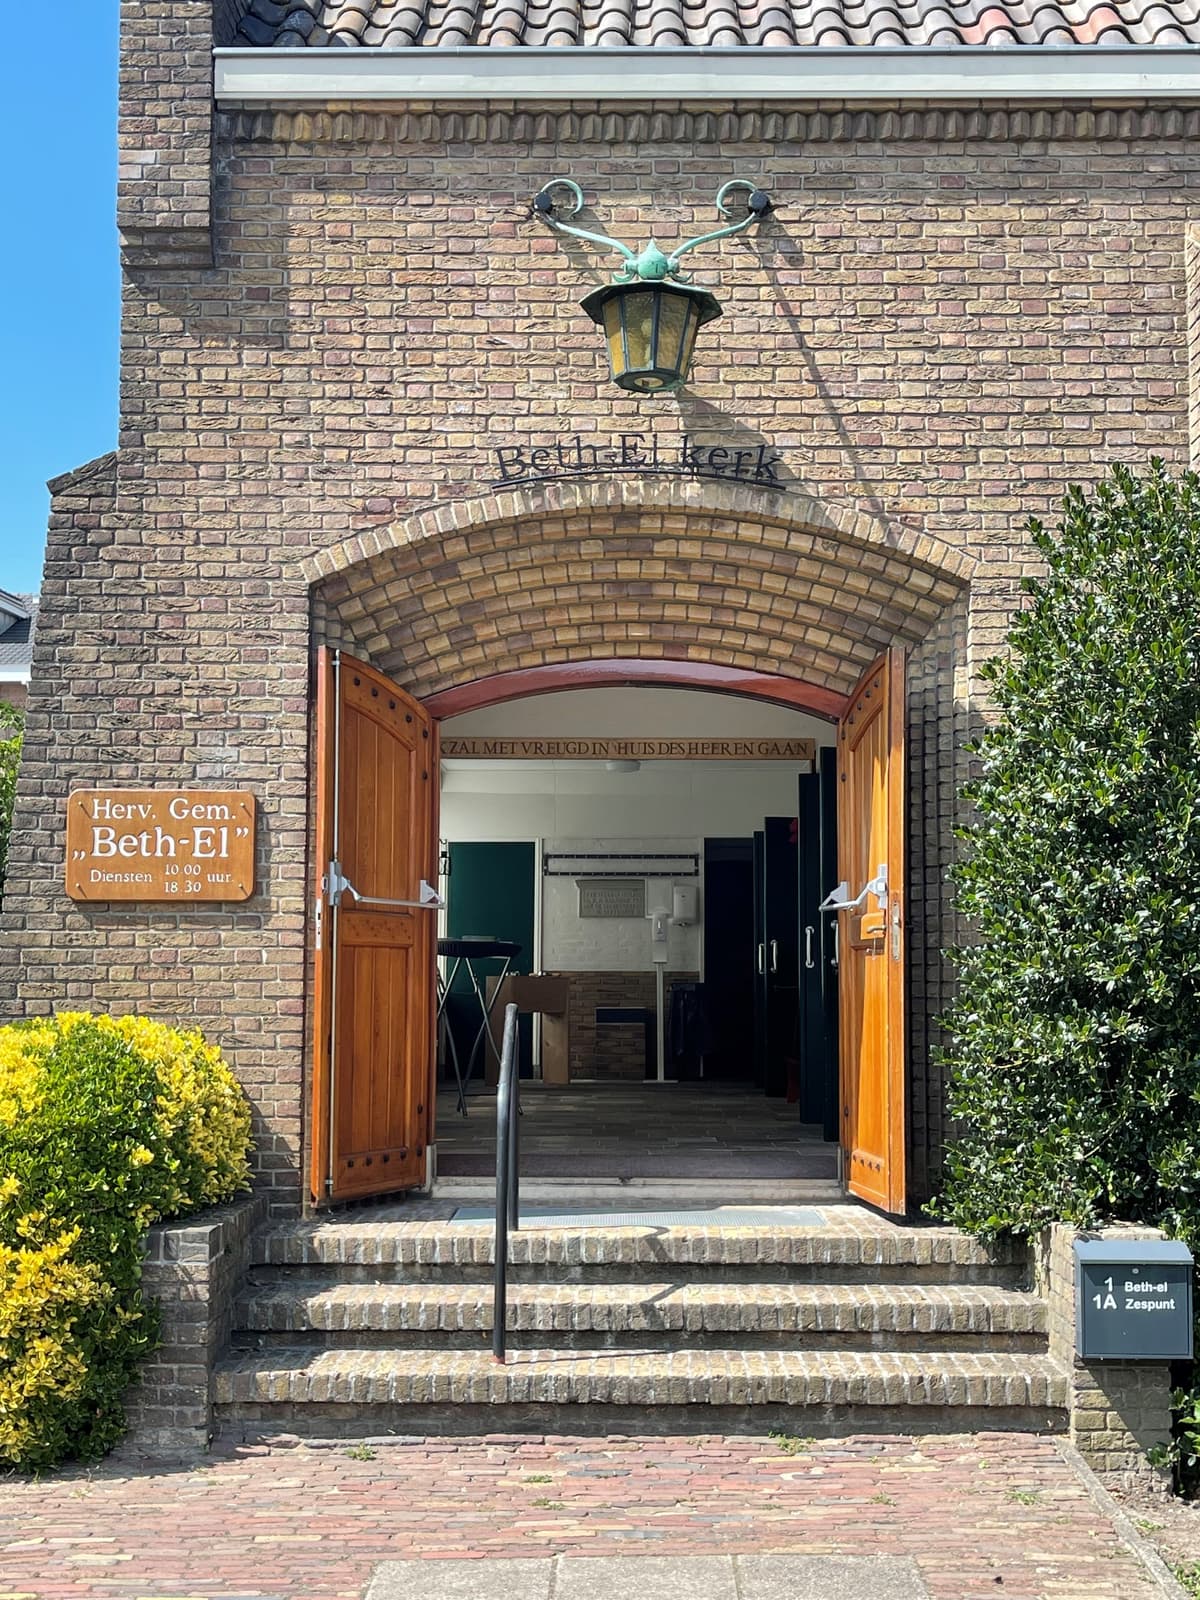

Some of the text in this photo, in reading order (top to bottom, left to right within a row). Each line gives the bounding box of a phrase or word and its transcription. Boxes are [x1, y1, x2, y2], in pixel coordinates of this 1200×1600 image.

[681, 434, 787, 483] kerk
[449, 741, 478, 755] ZAL
[482, 741, 516, 755] MET
[520, 741, 589, 755] VREUGD
[592, 741, 609, 755] IN
[658, 742, 686, 755] DES
[757, 742, 808, 755] GAAN
[91, 797, 237, 820] Herv. Gem.
[90, 869, 153, 883] Diensten
[1104, 1276, 1168, 1292] 1 Beth-el
[1093, 1293, 1176, 1312] 1A Zespunt
